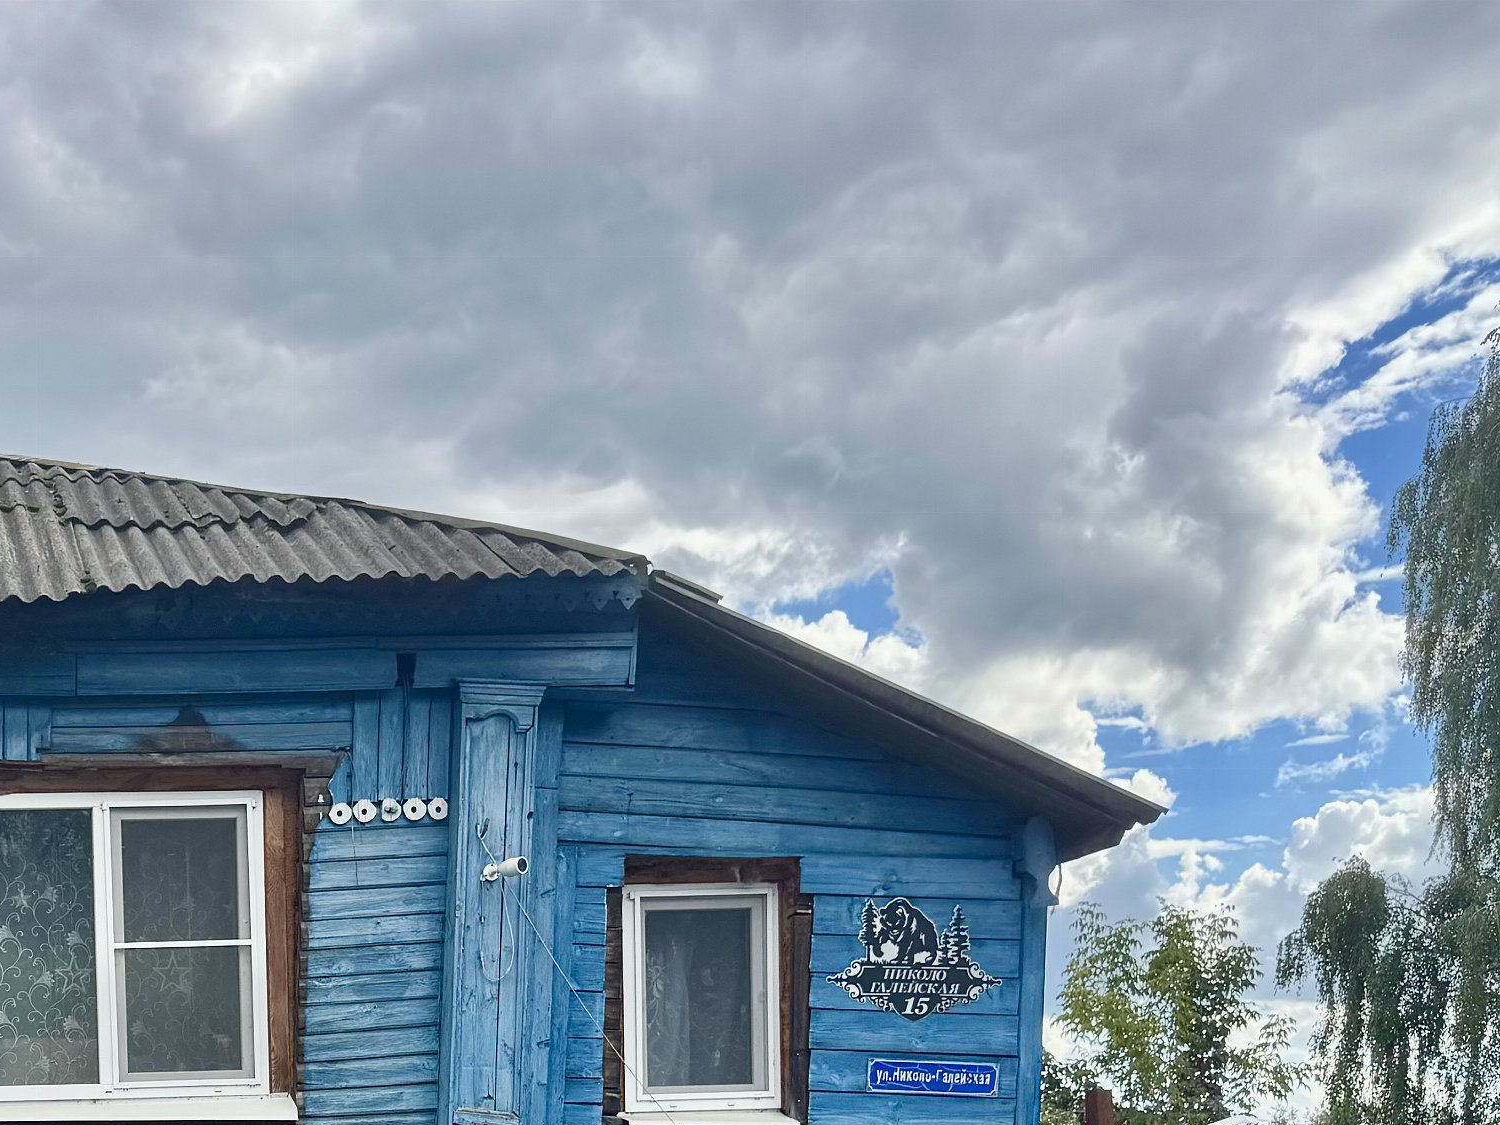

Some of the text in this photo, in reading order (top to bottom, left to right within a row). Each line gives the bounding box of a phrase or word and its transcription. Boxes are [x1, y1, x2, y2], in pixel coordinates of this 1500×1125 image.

[883, 968, 946, 981] НИКОЛО
[870, 980, 960, 994] ГАЛЕЙСКАЯ
[902, 997, 930, 1015] 15
